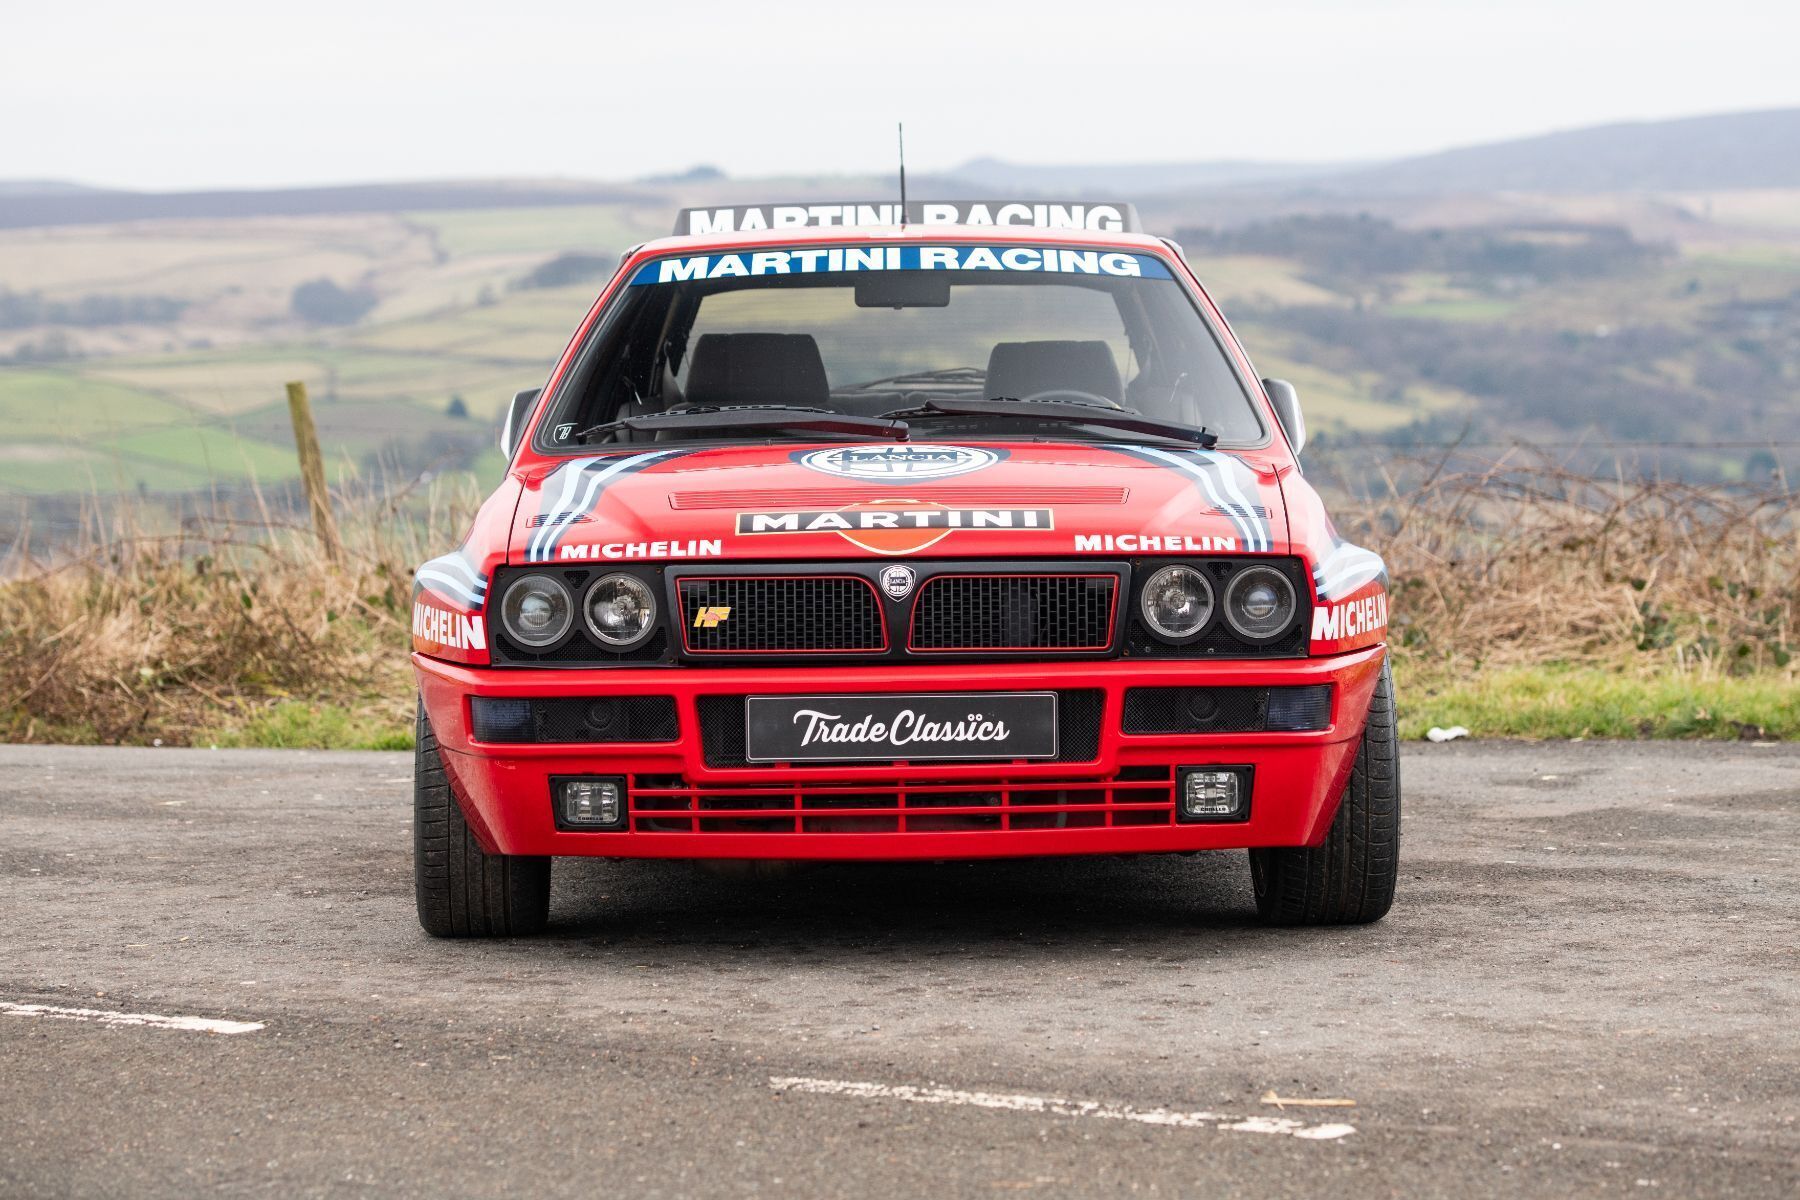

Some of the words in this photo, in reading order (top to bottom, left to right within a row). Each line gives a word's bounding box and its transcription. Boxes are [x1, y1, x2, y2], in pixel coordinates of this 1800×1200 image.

[690, 204, 902, 236] MARTINI
[923, 203, 1123, 233] RACING
[658, 247, 901, 283] MARTINI
[919, 247, 1142, 278] RACING
[849, 454, 952, 462] LANCIA
[752, 510, 1039, 532] MARTINI
[560, 539, 722, 560] MICHELIN
[1074, 534, 1236, 552] MICHELIN
[412, 601, 487, 650] MICHELIN
[1310, 591, 1388, 641] MICHELIN
[793, 709, 889, 747] Trade
